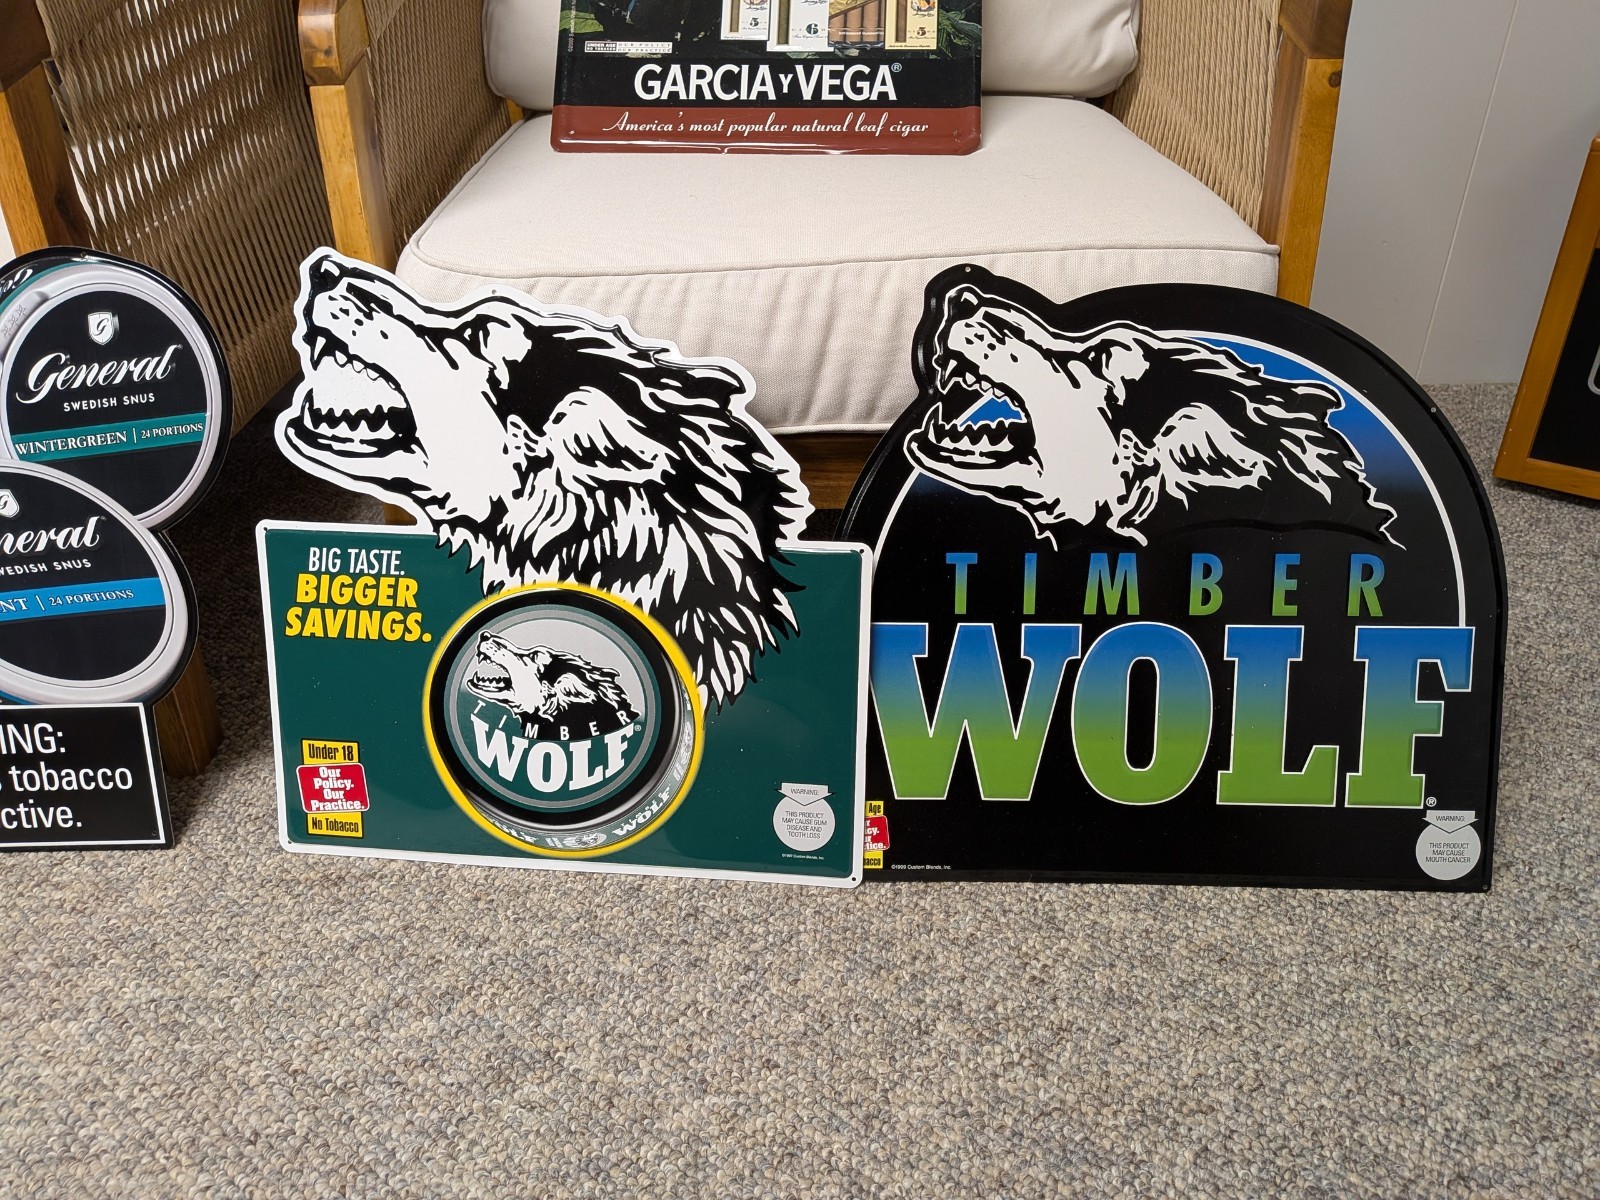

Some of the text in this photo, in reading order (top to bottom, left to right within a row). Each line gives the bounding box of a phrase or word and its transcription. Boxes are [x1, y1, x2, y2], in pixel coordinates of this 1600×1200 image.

[805, 23, 819, 35] 6
[634, 64, 776, 100] GARCIA
[778, 74, 794, 93] Y
[602, 111, 929, 137] America's most popular natural leaf cigar
[16, 344, 178, 404] General
[64, 393, 155, 412] SWEDISH SNUS
[14, 423, 203, 455] WINTERGREEN 24 PORTIONS
[53, 559, 92, 570] SNUS
[308, 547, 405, 576] BIG TASTE.
[296, 574, 418, 607] BIGGER
[945, 552, 1385, 618] TIMBER
[49, 597, 62, 606] 24
[65, 589, 135, 604] PORTIONS
[285, 607, 432, 642] SAVINGS.
[473, 700, 632, 741] TIMBER
[308, 743, 354, 761] Under 18
[8, 761, 133, 792] tobacco
[319, 766, 341, 778] Our
[313, 777, 354, 790] Policy.
[791, 788, 819, 796] WARNING:
[323, 789, 344, 800] Our
[310, 799, 365, 811] Practice.
[868, 803, 881, 815] Age
[312, 817, 359, 833] No Tobacco
